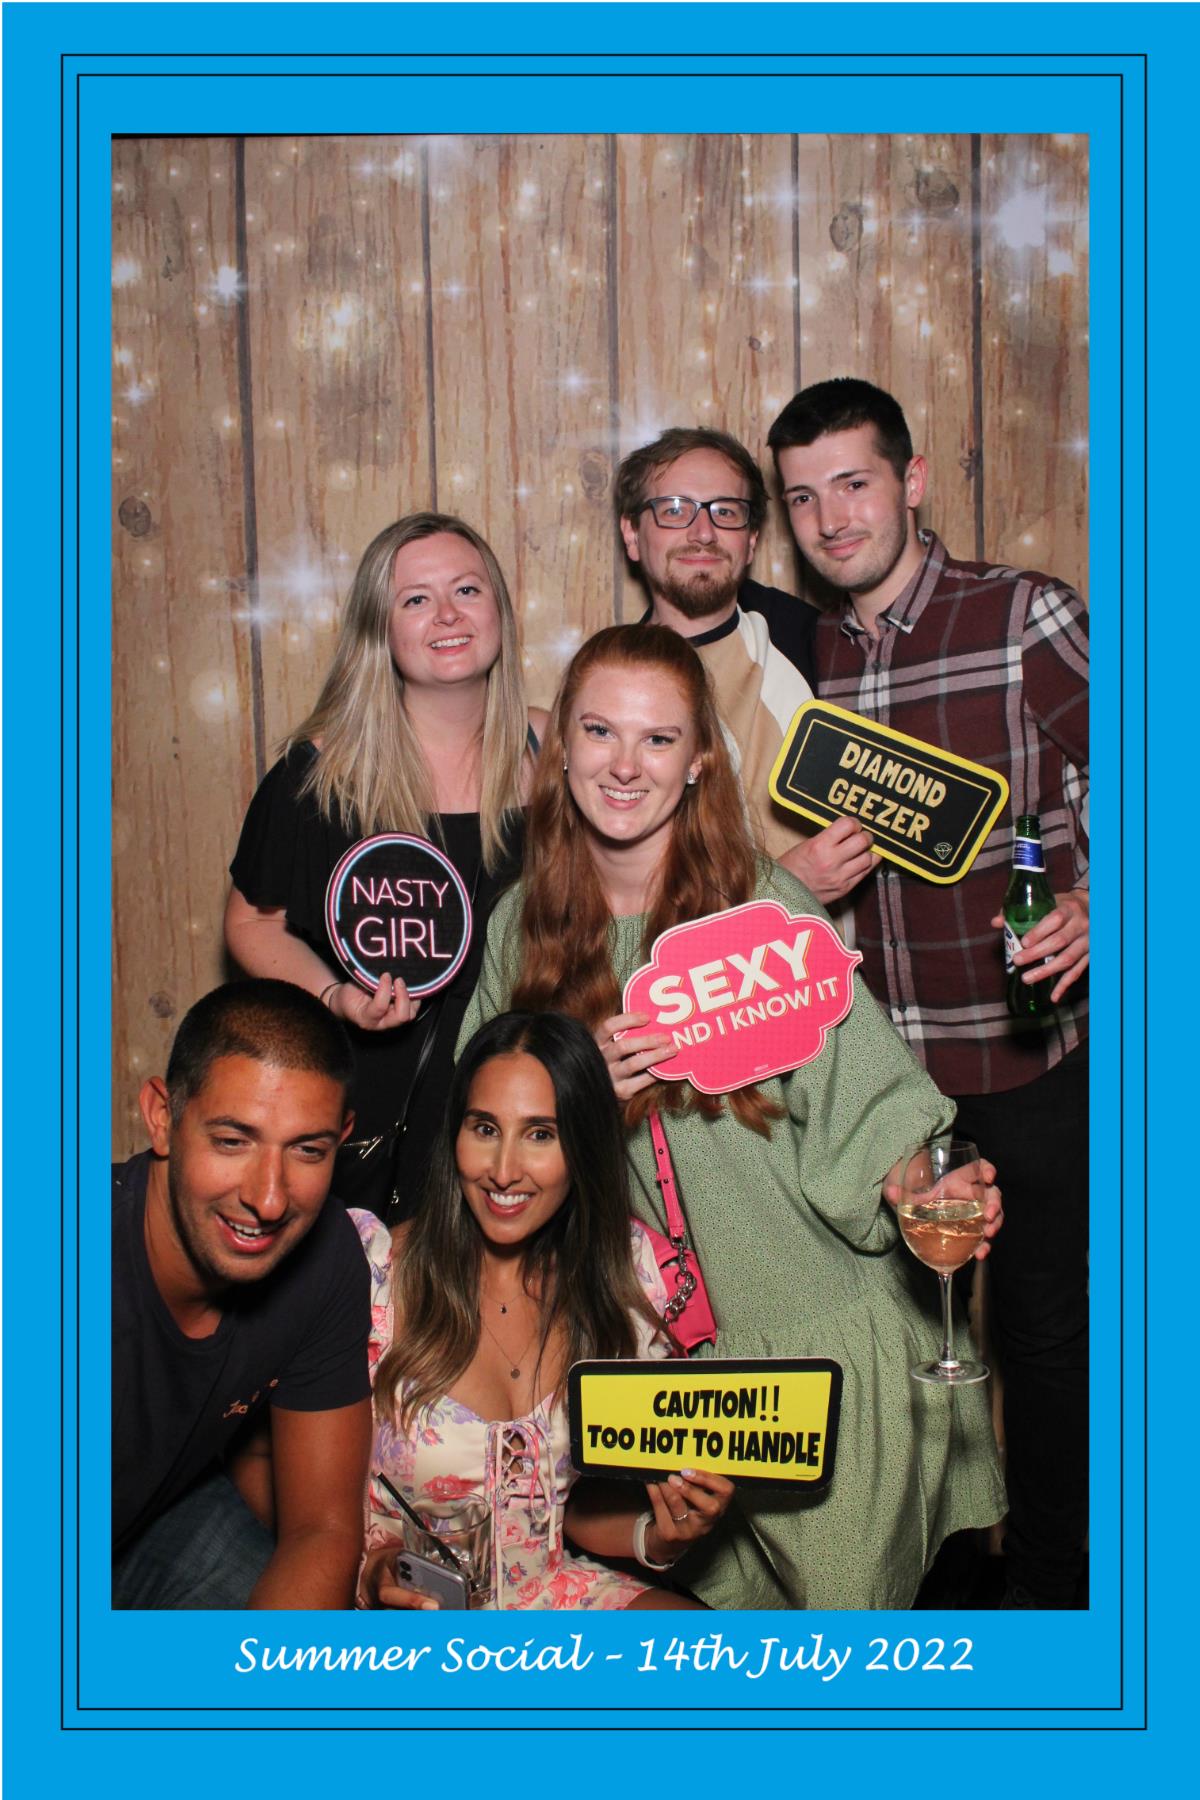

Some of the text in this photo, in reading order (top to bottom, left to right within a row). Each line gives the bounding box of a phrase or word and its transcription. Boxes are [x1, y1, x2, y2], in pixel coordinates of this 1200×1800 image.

[838, 742, 947, 808] DIAMOND
[827, 778, 931, 843] GEEZER
[352, 876, 449, 908] NASTY
[354, 917, 453, 959] GIRL
[648, 929, 814, 1025] SEXY
[715, 1015, 726, 1035] I
[729, 985, 811, 1031] KNOW
[816, 976, 838, 1001] IT
[652, 1385, 780, 1422] CAUTION!!
[587, 1425, 821, 1467] TOO HOT TO HANDLE
